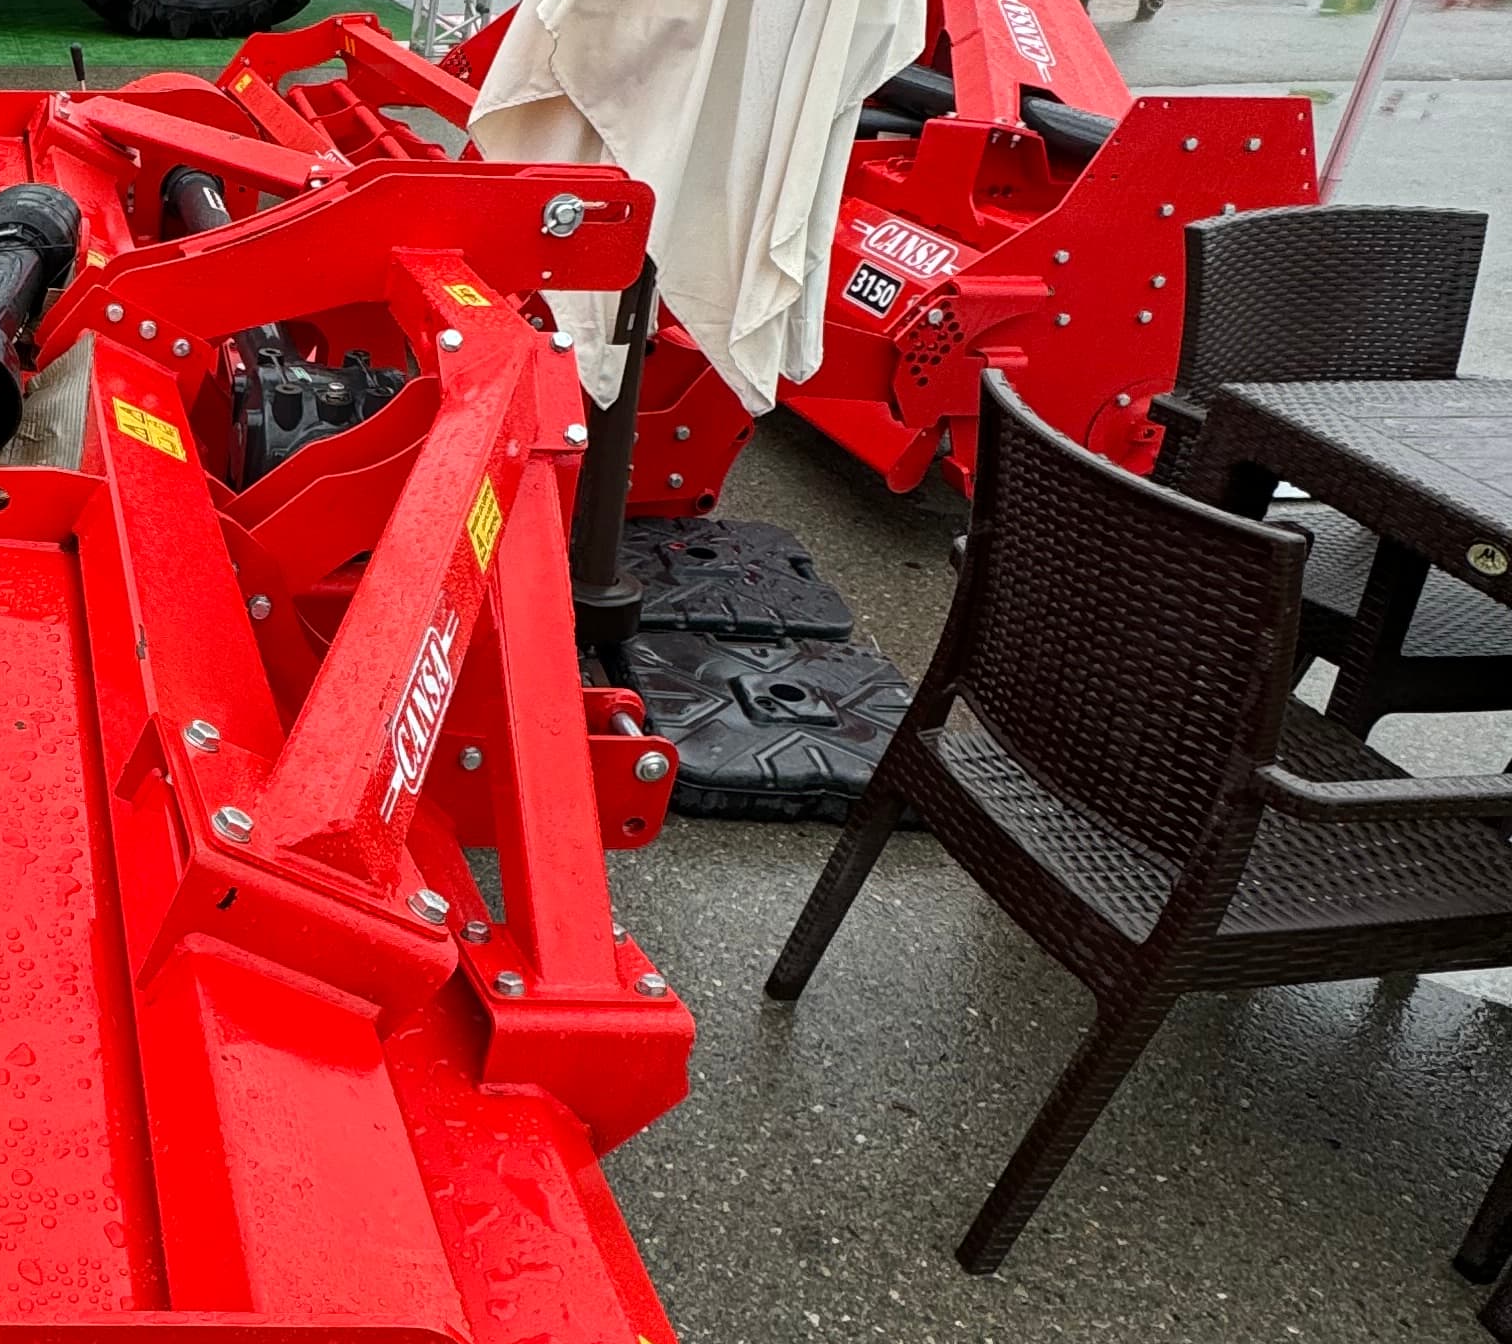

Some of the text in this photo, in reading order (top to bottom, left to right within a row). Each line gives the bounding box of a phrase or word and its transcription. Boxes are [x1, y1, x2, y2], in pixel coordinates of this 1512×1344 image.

[1002, 3, 1050, 63] CANSA
[868, 224, 950, 274] CANSA
[850, 269, 896, 308] 3150
[397, 639, 449, 781] CANSA
